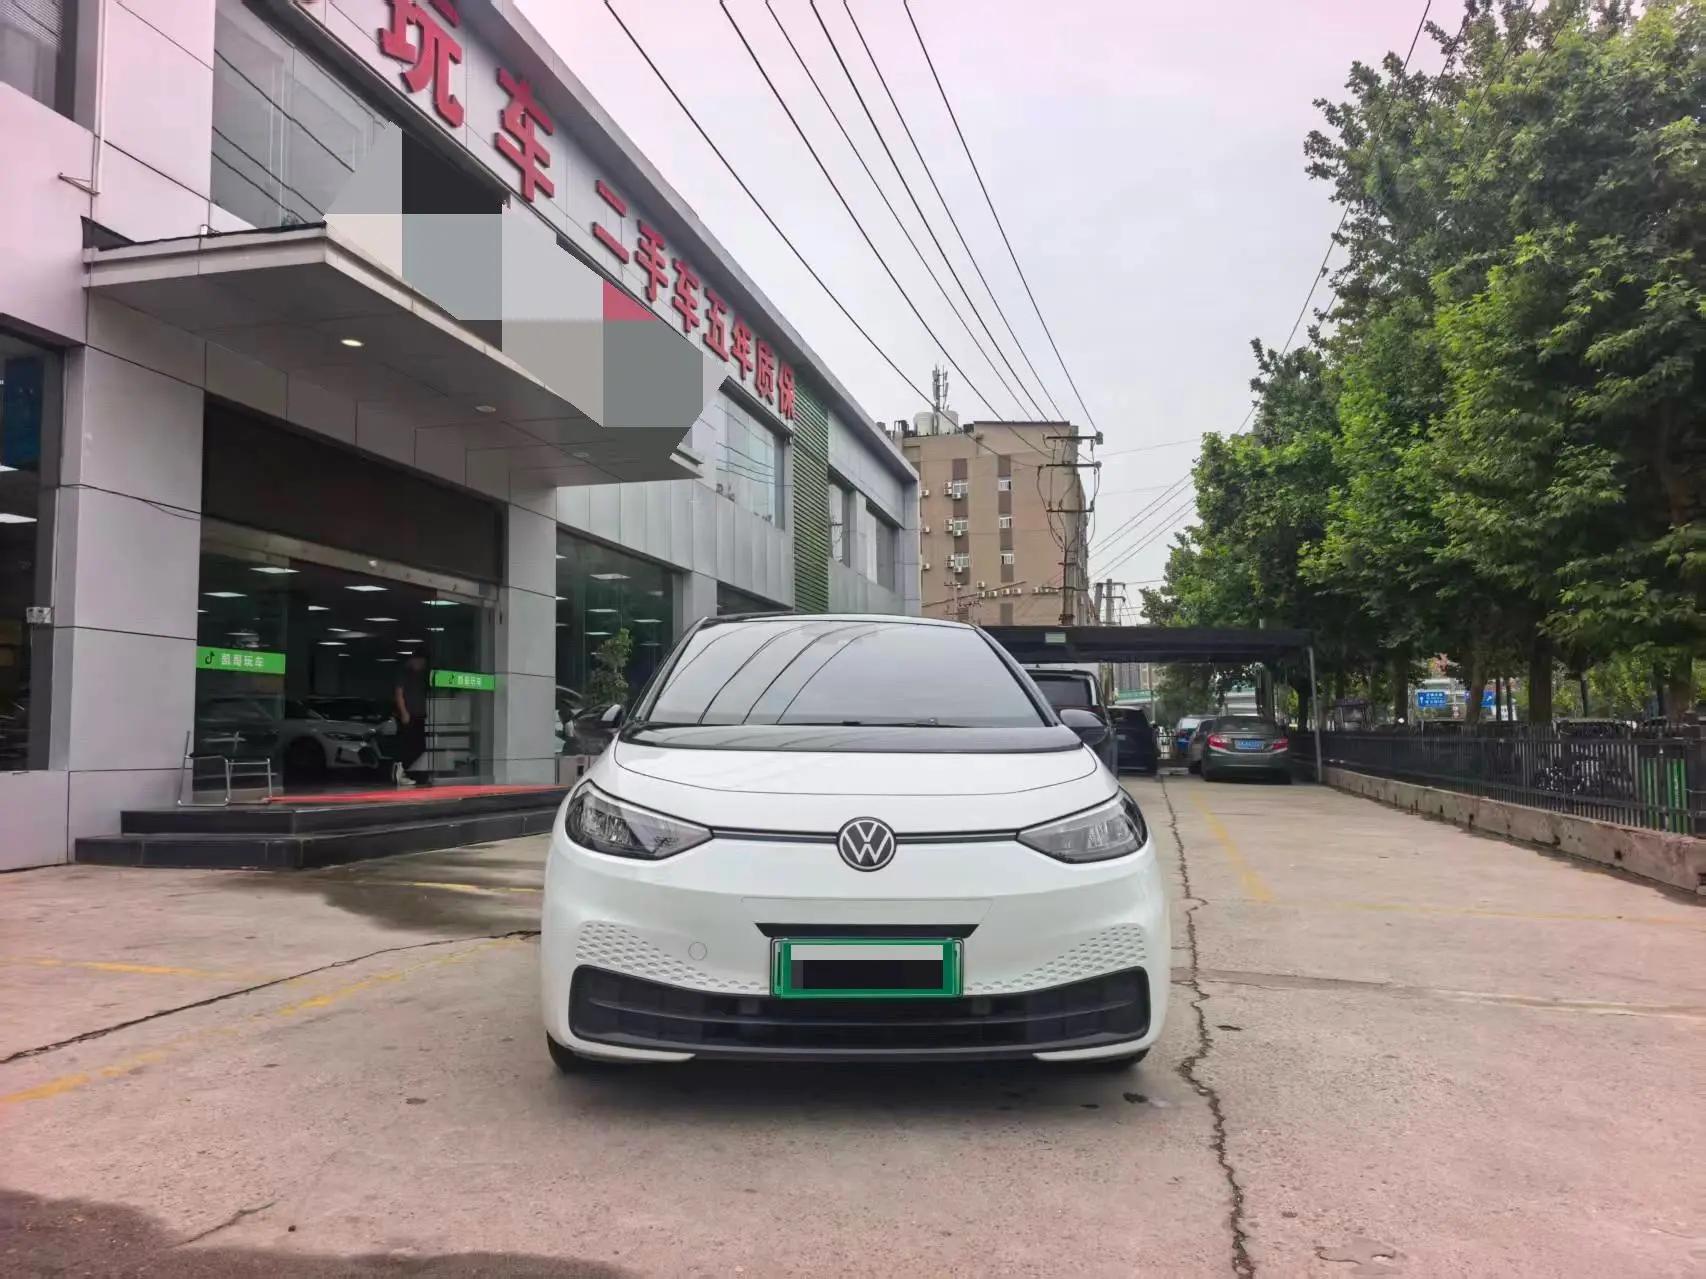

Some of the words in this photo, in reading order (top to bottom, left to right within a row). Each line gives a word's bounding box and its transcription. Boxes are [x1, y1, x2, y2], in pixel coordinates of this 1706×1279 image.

[592, 179, 795, 420] 二手车五年质保
